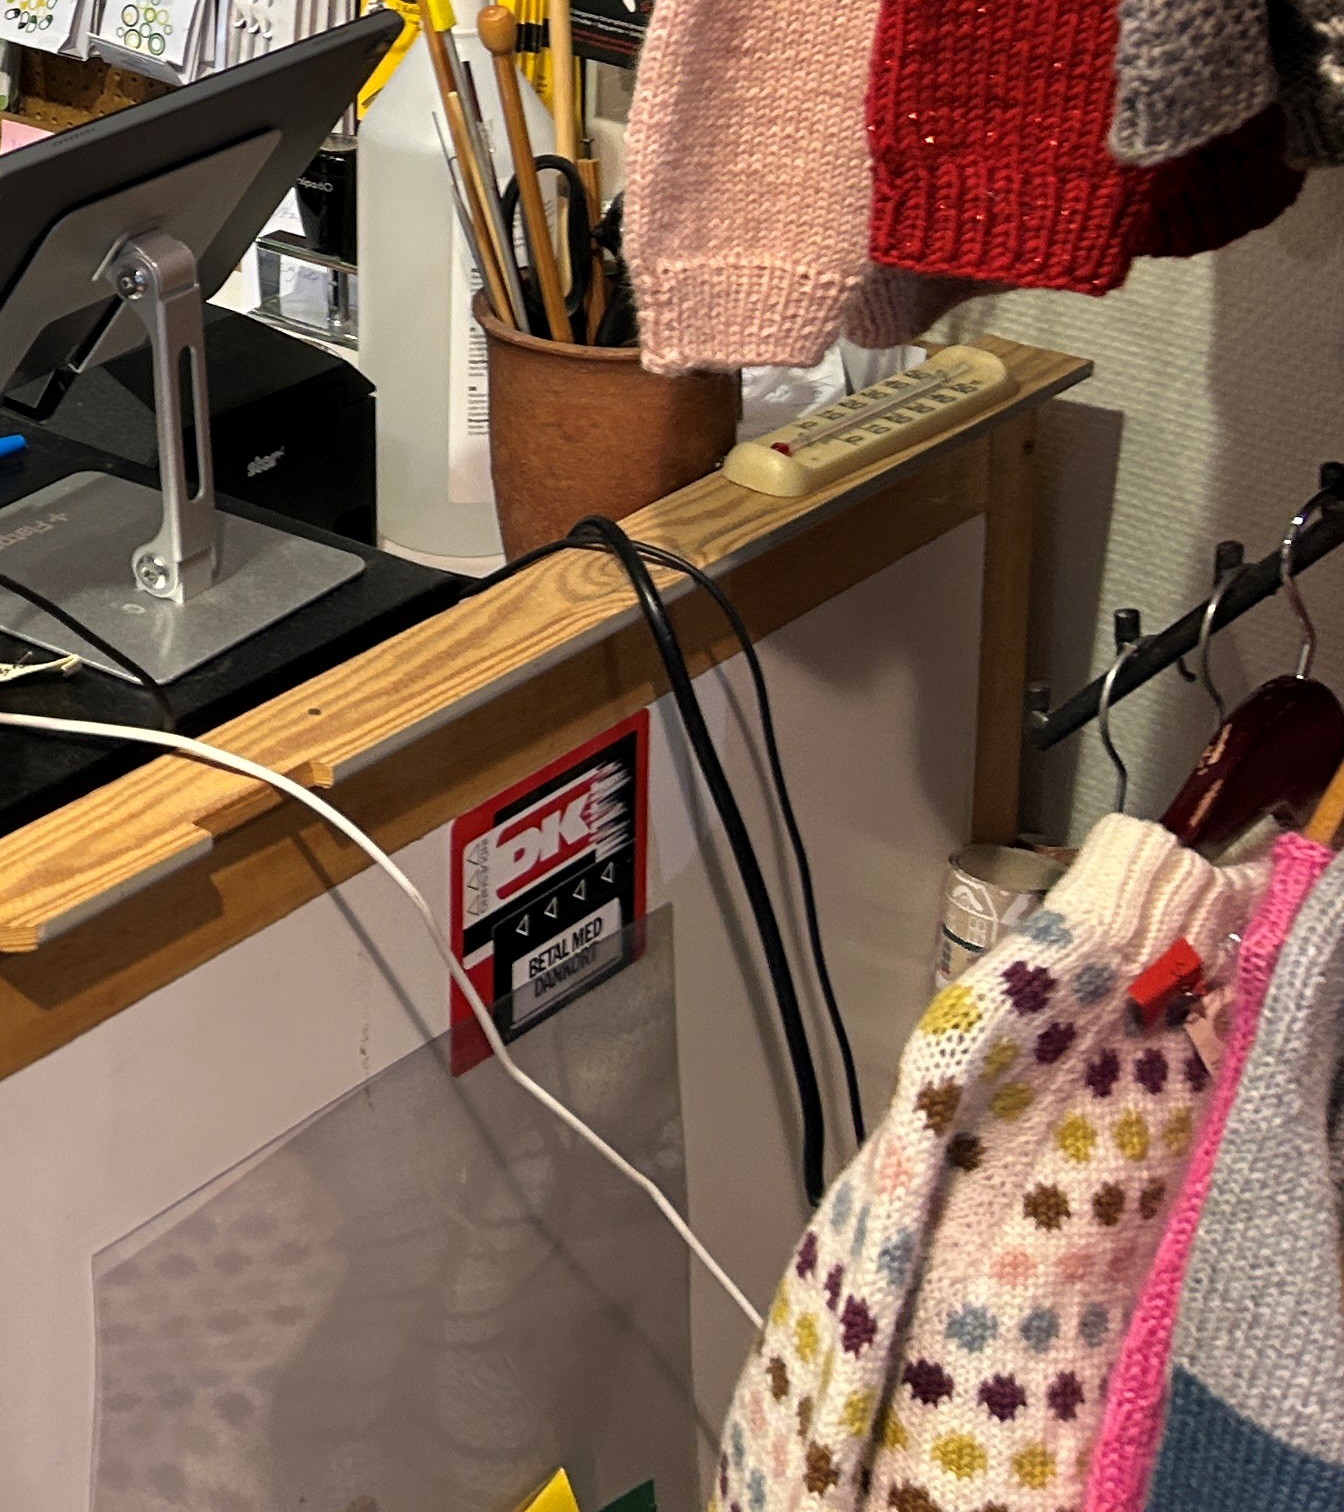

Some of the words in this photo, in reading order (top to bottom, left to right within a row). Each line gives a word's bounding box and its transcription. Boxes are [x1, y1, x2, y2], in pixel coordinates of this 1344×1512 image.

[528, 943, 569, 979] BETAL
[572, 917, 603, 952] MED
[534, 946, 599, 998] DANKORT
